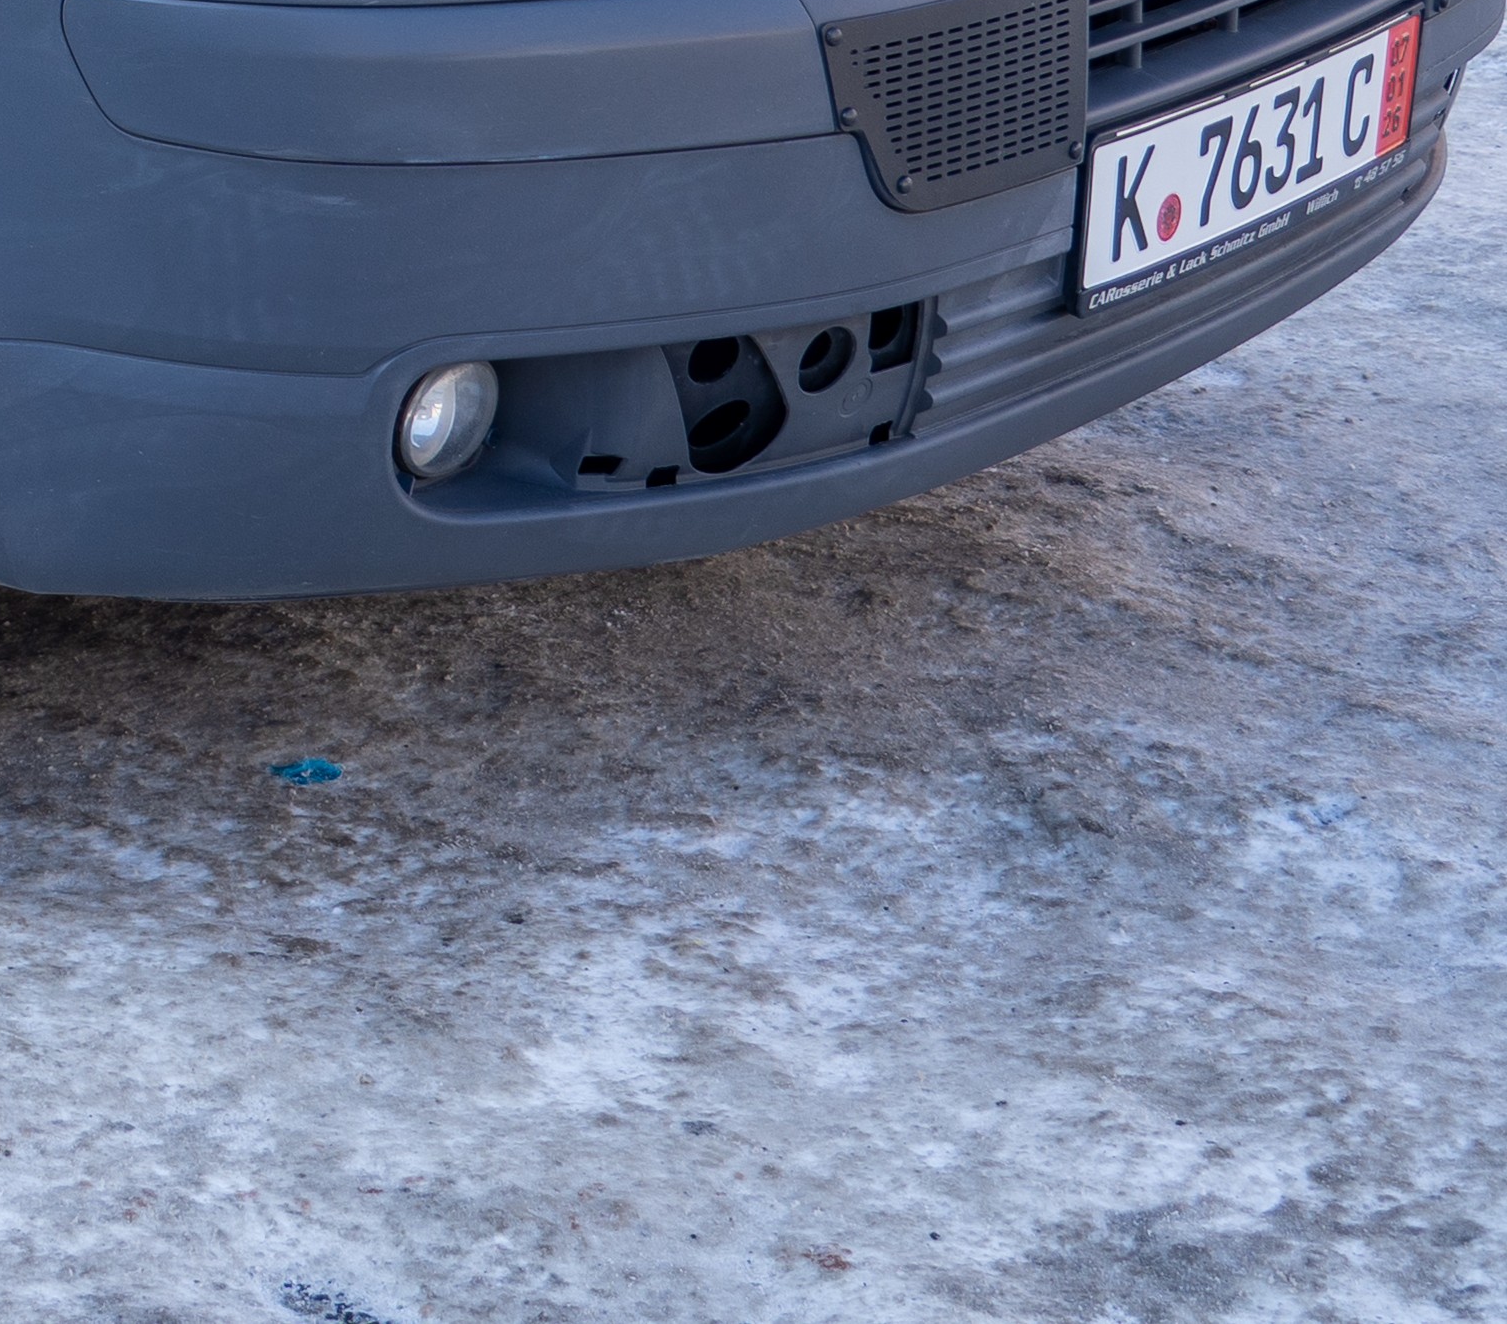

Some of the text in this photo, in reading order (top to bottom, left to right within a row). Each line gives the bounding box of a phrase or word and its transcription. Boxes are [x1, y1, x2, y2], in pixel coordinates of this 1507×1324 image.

[1390, 33, 1410, 66] 07
[1387, 68, 1405, 101] 01
[1111, 53, 1375, 263] K 7631 C
[1089, 271, 1164, 310] CARosserie
[1165, 263, 1177, 280] &
[1179, 251, 1206, 274] Lack
[1209, 230, 1256, 261] Schmitz
[1258, 211, 1291, 239] GmbH
